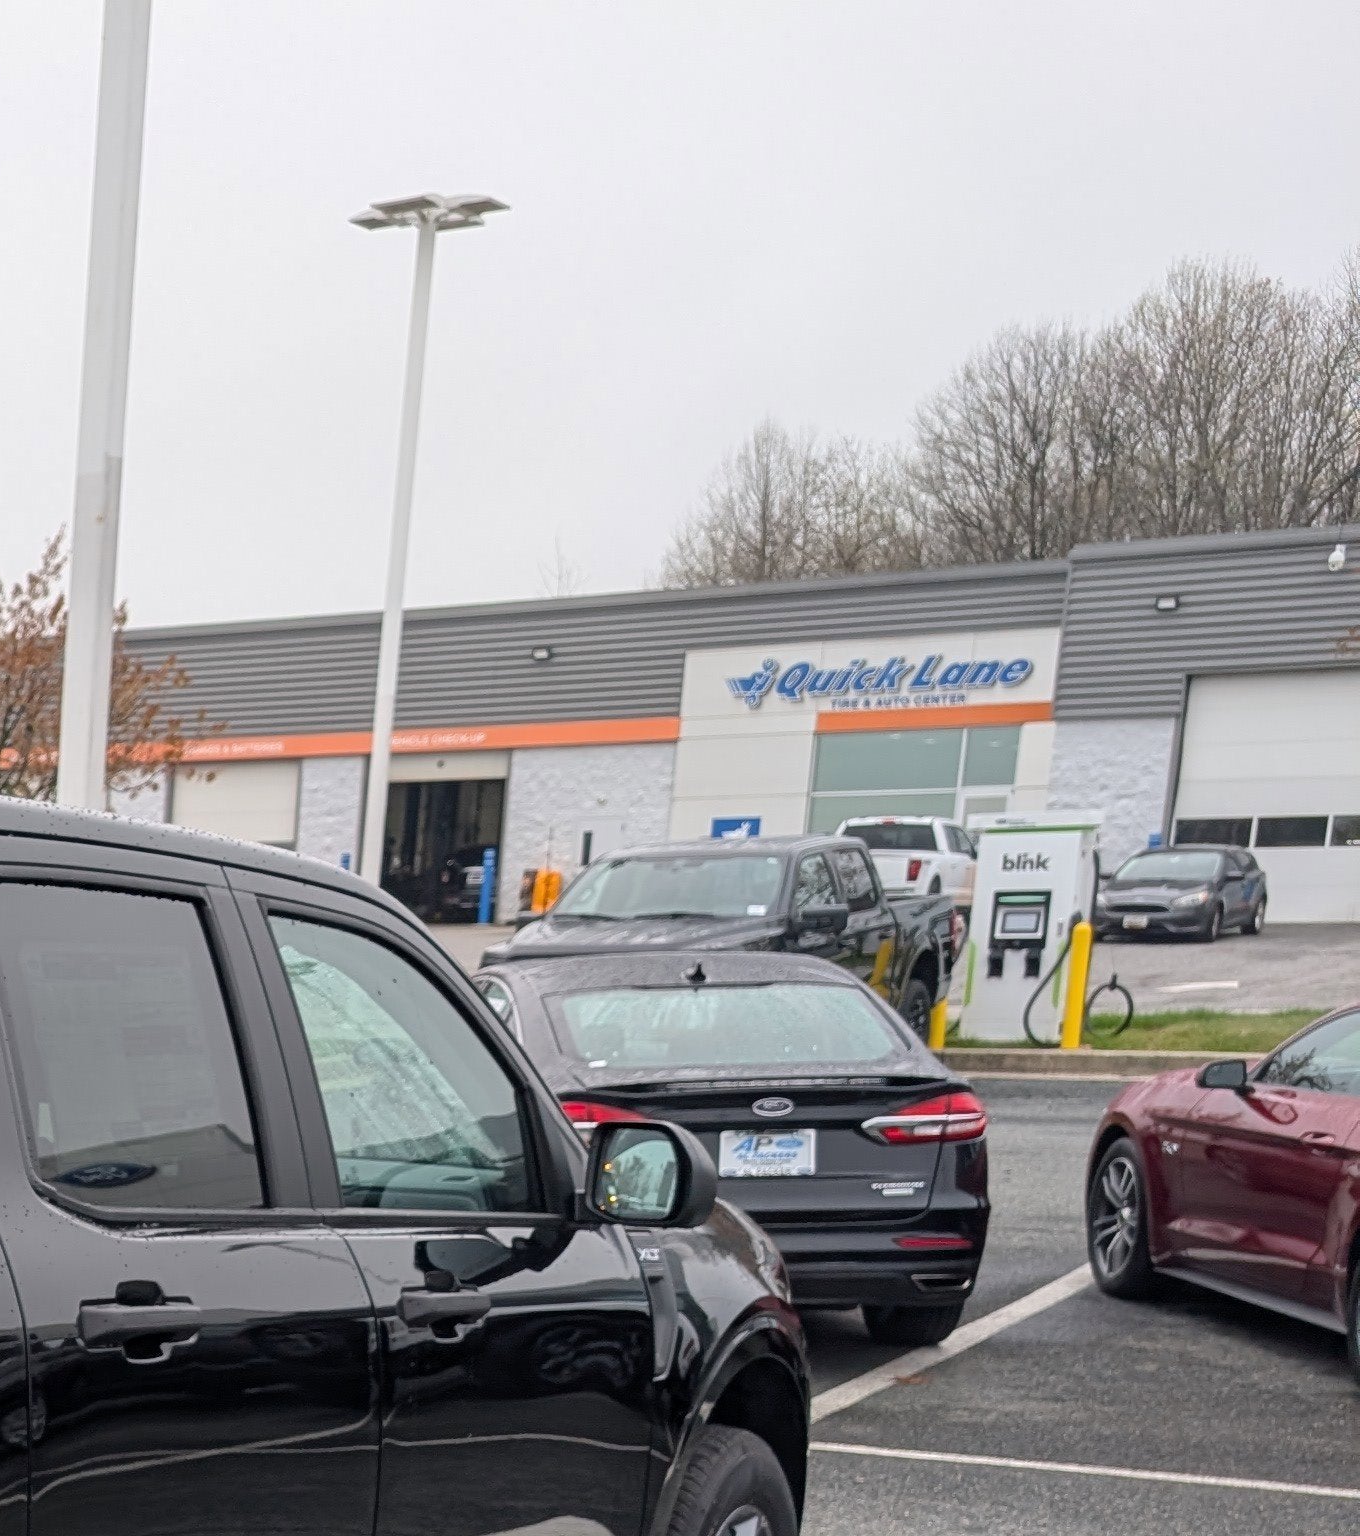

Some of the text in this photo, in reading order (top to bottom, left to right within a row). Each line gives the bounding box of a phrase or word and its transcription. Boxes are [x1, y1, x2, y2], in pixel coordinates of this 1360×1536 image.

[776, 652, 1034, 702] Quick Lane
[830, 697, 858, 709] TIRE
[876, 695, 910, 707] AUTO
[913, 692, 967, 706] CENTER
[1001, 852, 1050, 872] blink
